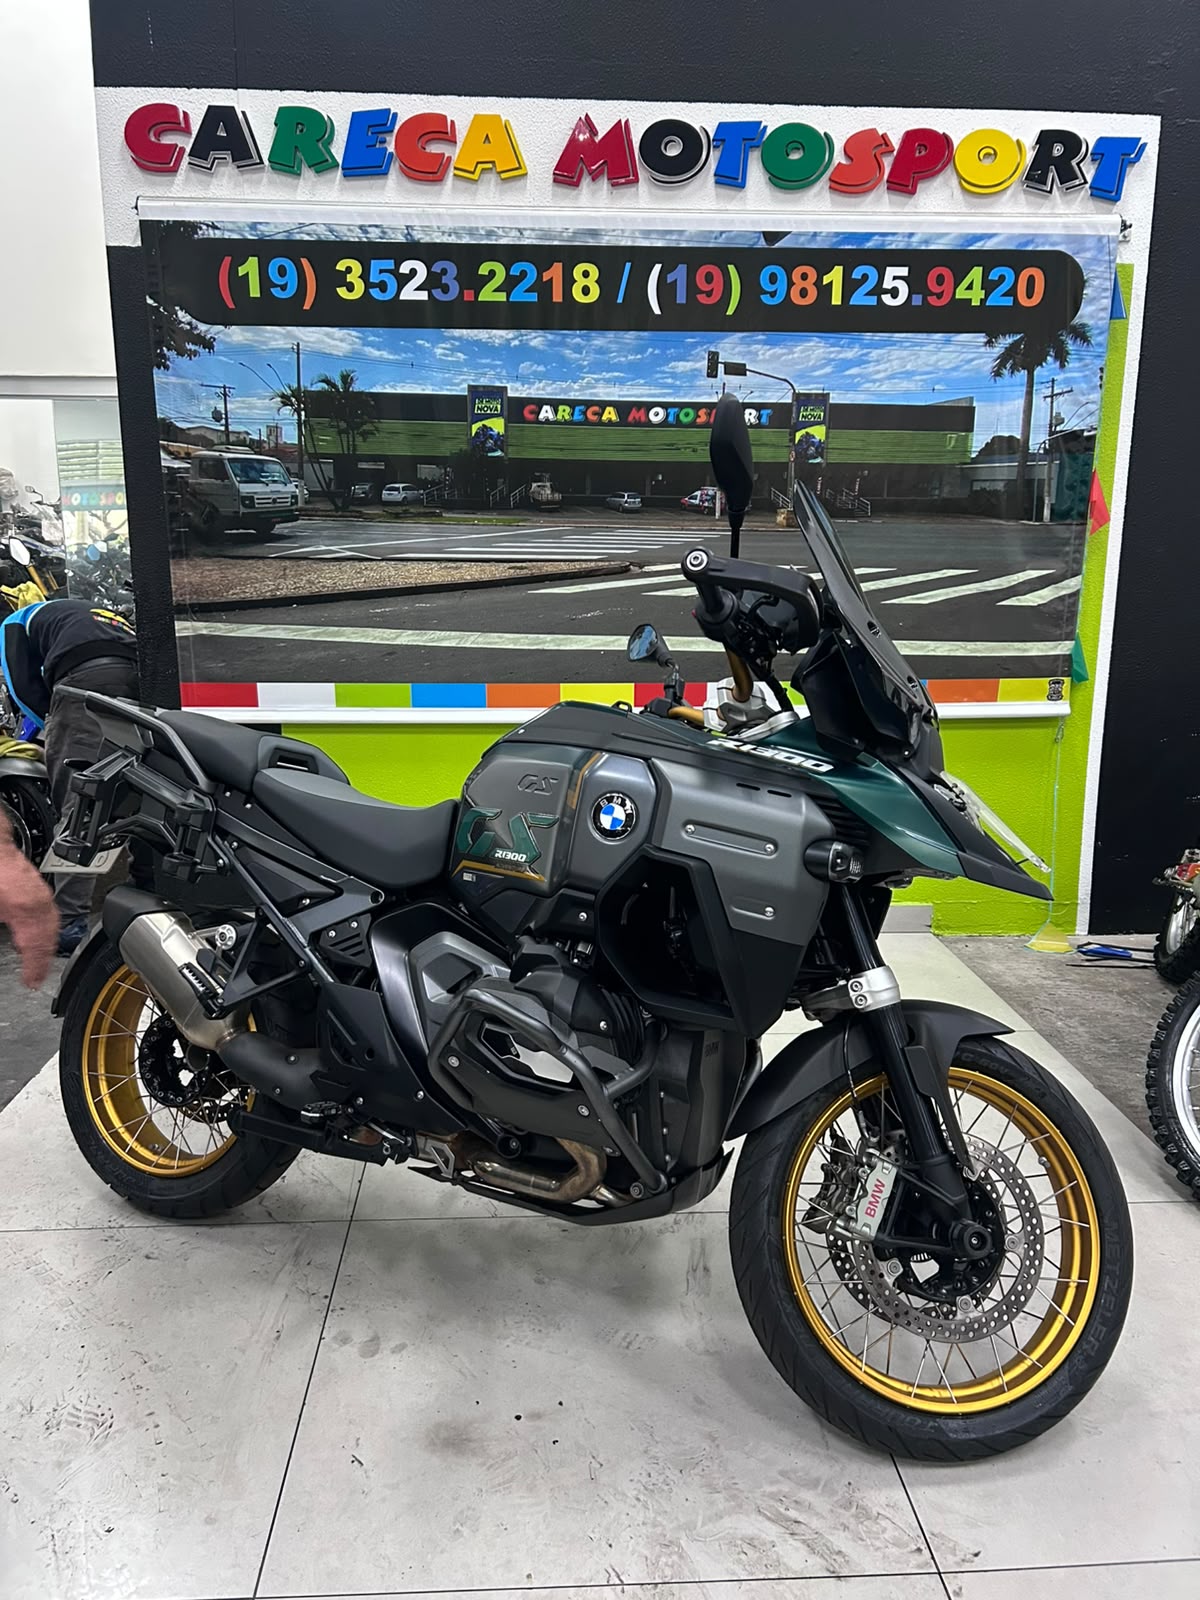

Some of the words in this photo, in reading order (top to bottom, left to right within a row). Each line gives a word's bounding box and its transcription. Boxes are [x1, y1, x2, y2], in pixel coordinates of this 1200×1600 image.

[124, 102, 528, 182] CARECA
[553, 112, 1148, 201] MOTOSPORT
[218, 256, 317, 311] (19)
[335, 258, 601, 303] 3523.2218
[616, 261, 632, 304] /
[647, 263, 742, 316] (19)
[759, 263, 1046, 308] 98125.9420
[476, 404, 499, 413] NOVA
[523, 403, 620, 424] CARECA
[627, 403, 774, 426] MOTOSRT
[599, 796, 633, 815] BMW
[494, 849, 527, 863] R1300
[865, 1178, 886, 1218] BMW
